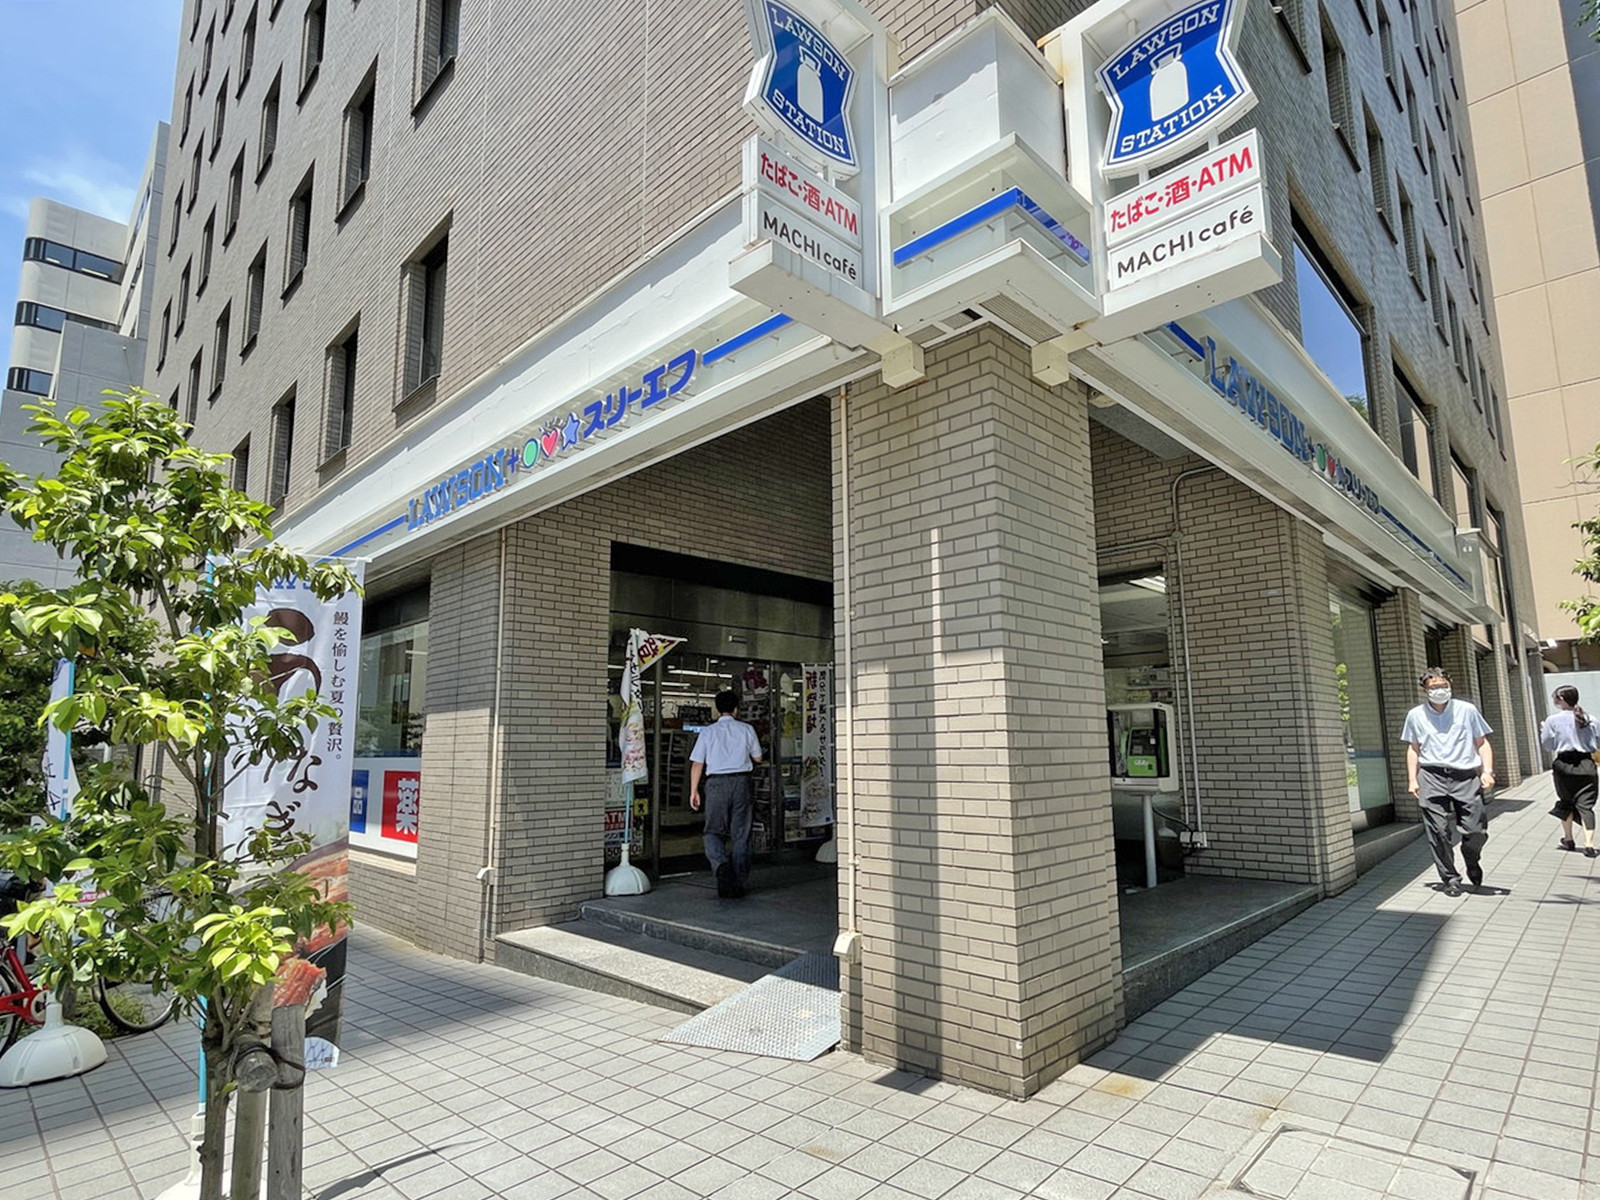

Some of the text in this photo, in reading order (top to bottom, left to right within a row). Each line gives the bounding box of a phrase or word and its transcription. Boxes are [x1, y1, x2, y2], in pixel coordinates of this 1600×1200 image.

[771, 7, 847, 81] LAWSON
[1112, 4, 1220, 80] LAWSON
[772, 88, 846, 155] STATION
[1120, 84, 1227, 153] STATION
[763, 211, 857, 280] MACHI café
[1117, 205, 1254, 279] MACHI café
[583, 348, 698, 439] スリーエフ
